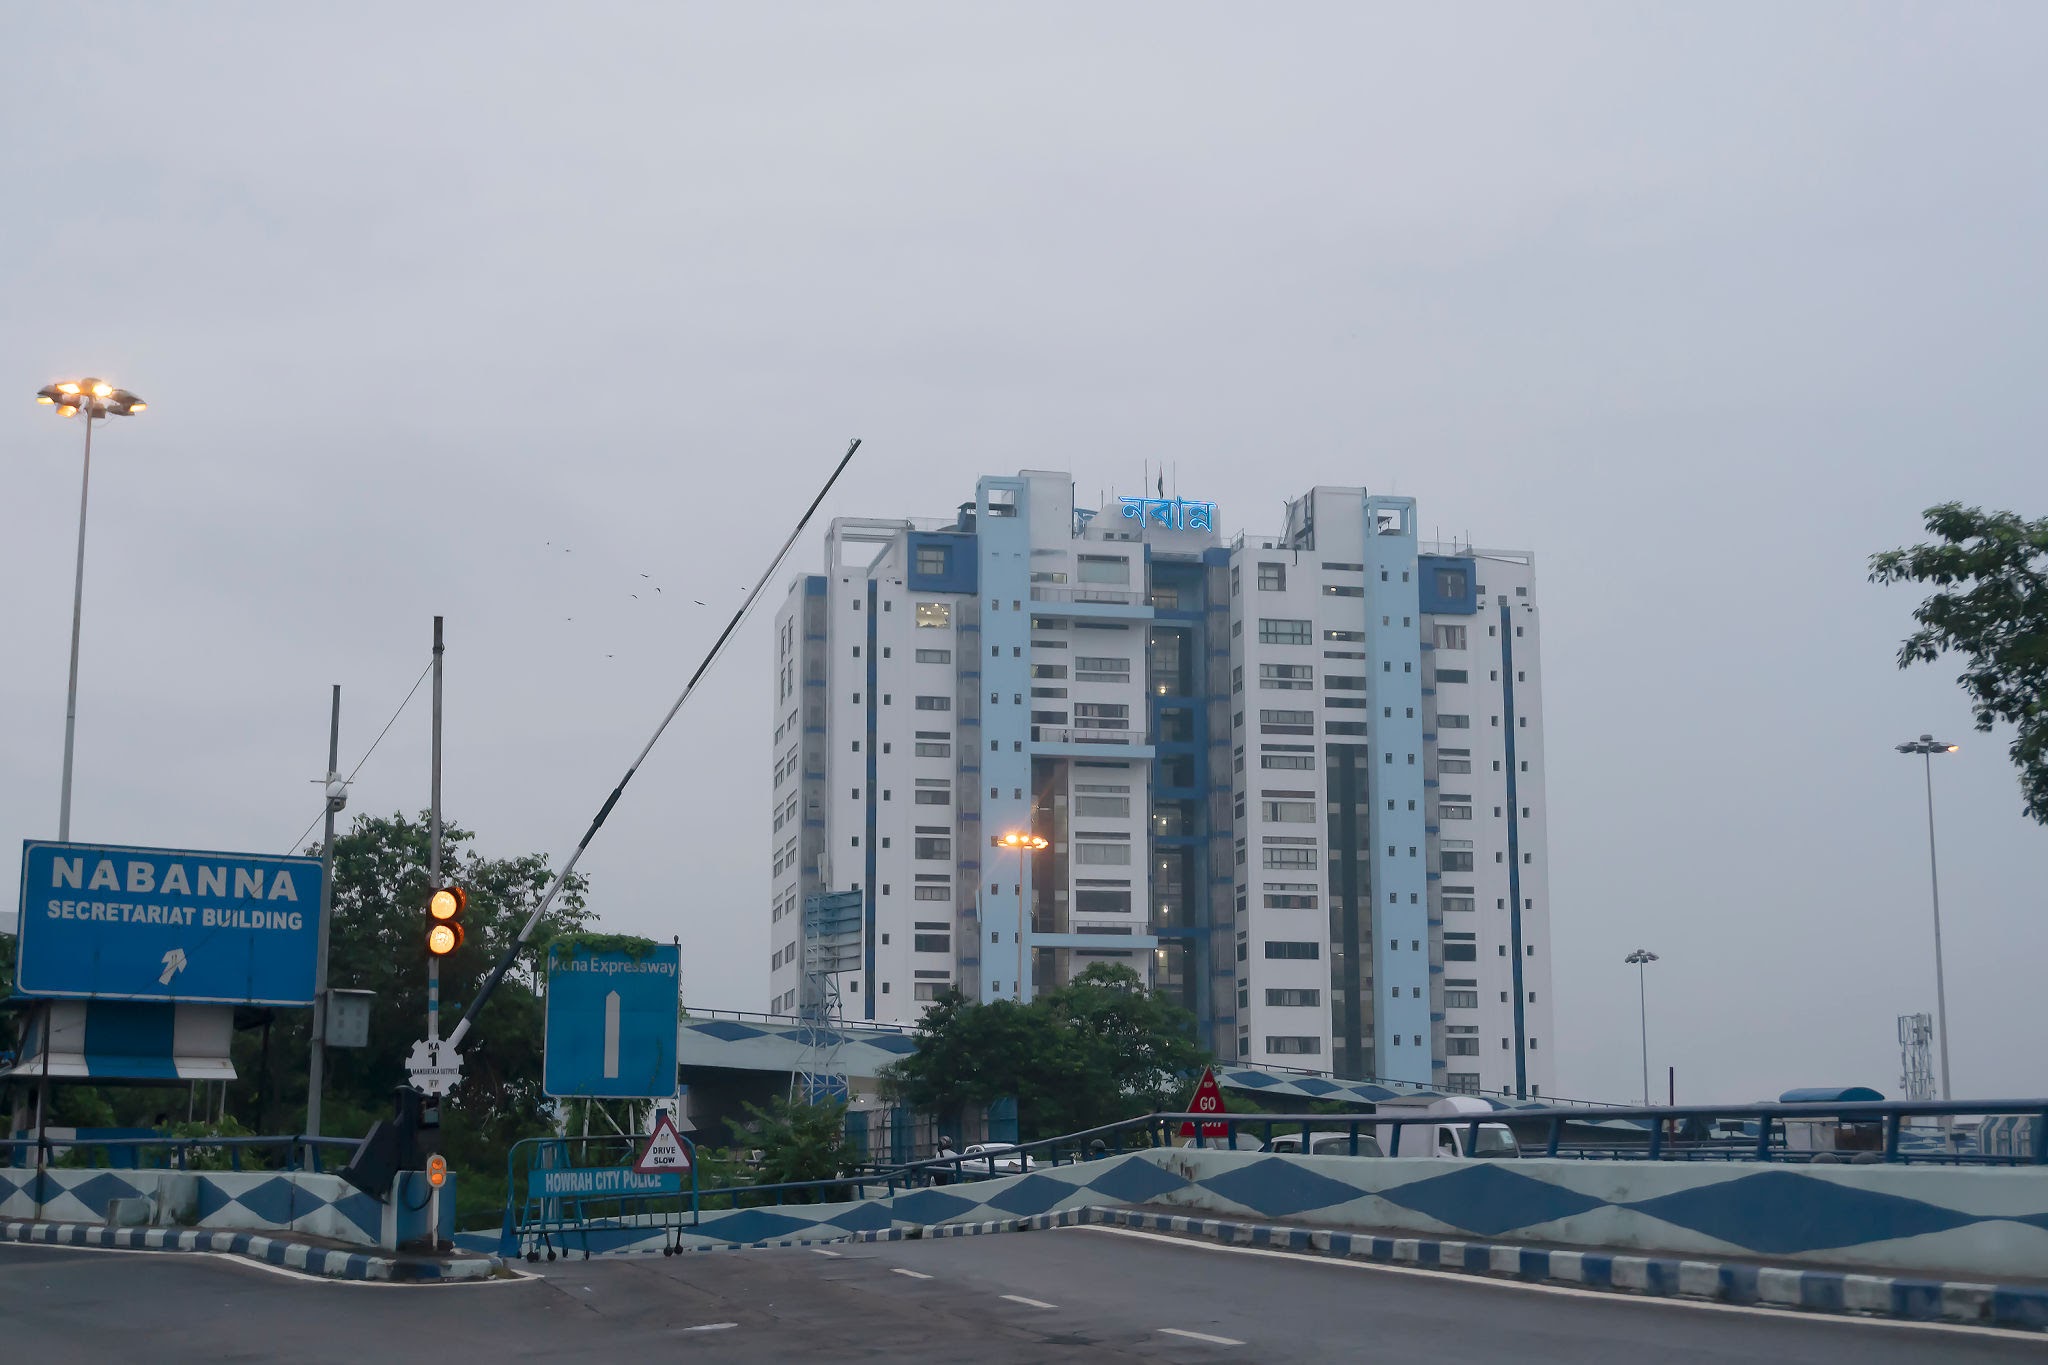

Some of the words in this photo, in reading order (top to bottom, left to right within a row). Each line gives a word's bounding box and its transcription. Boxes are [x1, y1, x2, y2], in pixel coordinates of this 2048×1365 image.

[1119, 495, 1217, 532] নবান্ন
[52, 857, 298, 901] NABANNA
[47, 900, 196, 926] SECRETARIAT
[202, 908, 302, 930] BUILDING
[590, 957, 677, 977] Expressway
[428, 1052, 437, 1066] 1
[1200, 1096, 1216, 1110] GO
[652, 1146, 676, 1155] DRIVE
[653, 1156, 676, 1165] SLOW
[545, 1172, 593, 1193] HOWRAH
[595, 1171, 621, 1189] CITY
[624, 1171, 661, 1188] POLICE
